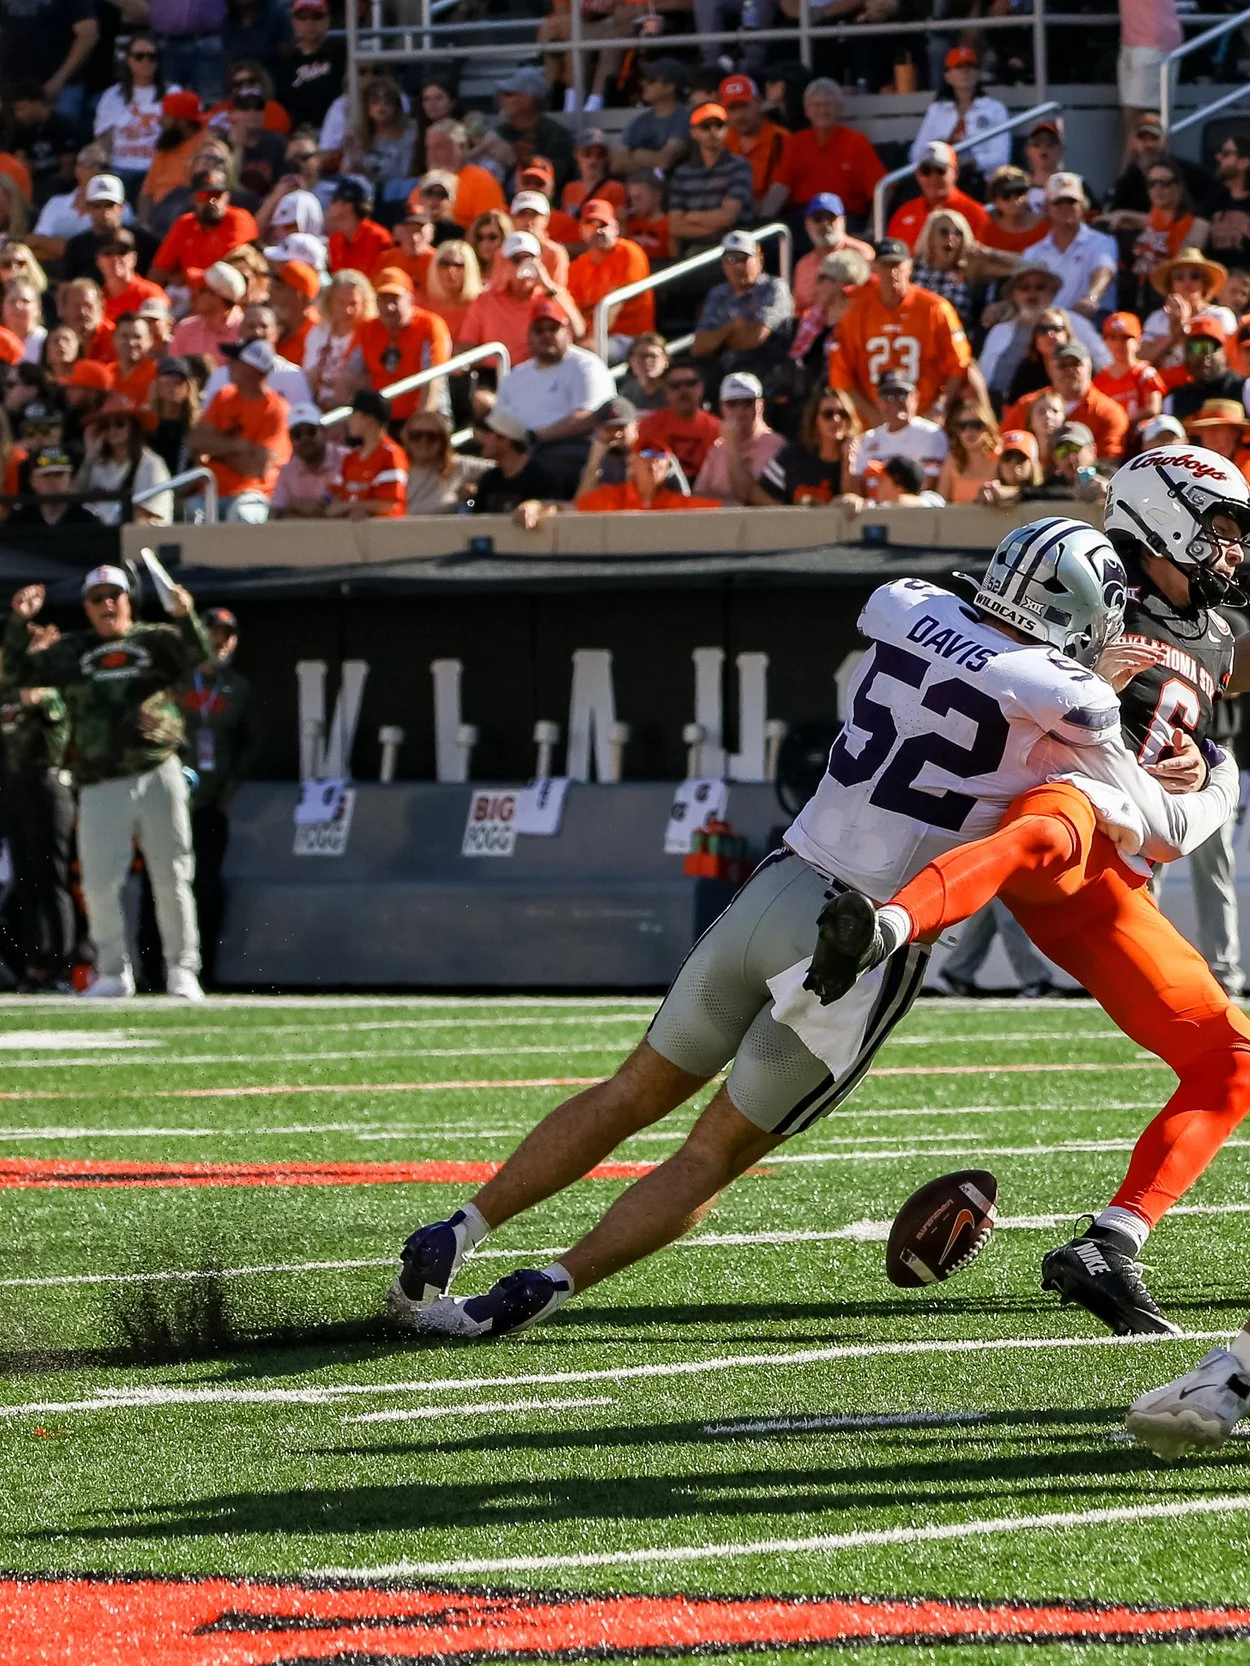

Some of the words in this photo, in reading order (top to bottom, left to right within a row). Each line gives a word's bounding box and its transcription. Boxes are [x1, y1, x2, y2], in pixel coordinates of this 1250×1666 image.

[866, 336, 920, 385] 23
[1130, 451, 1229, 481] Cowboys
[988, 577, 1000, 594] 52
[976, 592, 1037, 632] WILDCATS
[906, 615, 999, 672] DAVIS
[829, 640, 1010, 833] 52
[1138, 678, 1200, 767] 6
[475, 797, 515, 822] BIG
[1073, 1241, 1111, 1276] NIKE
